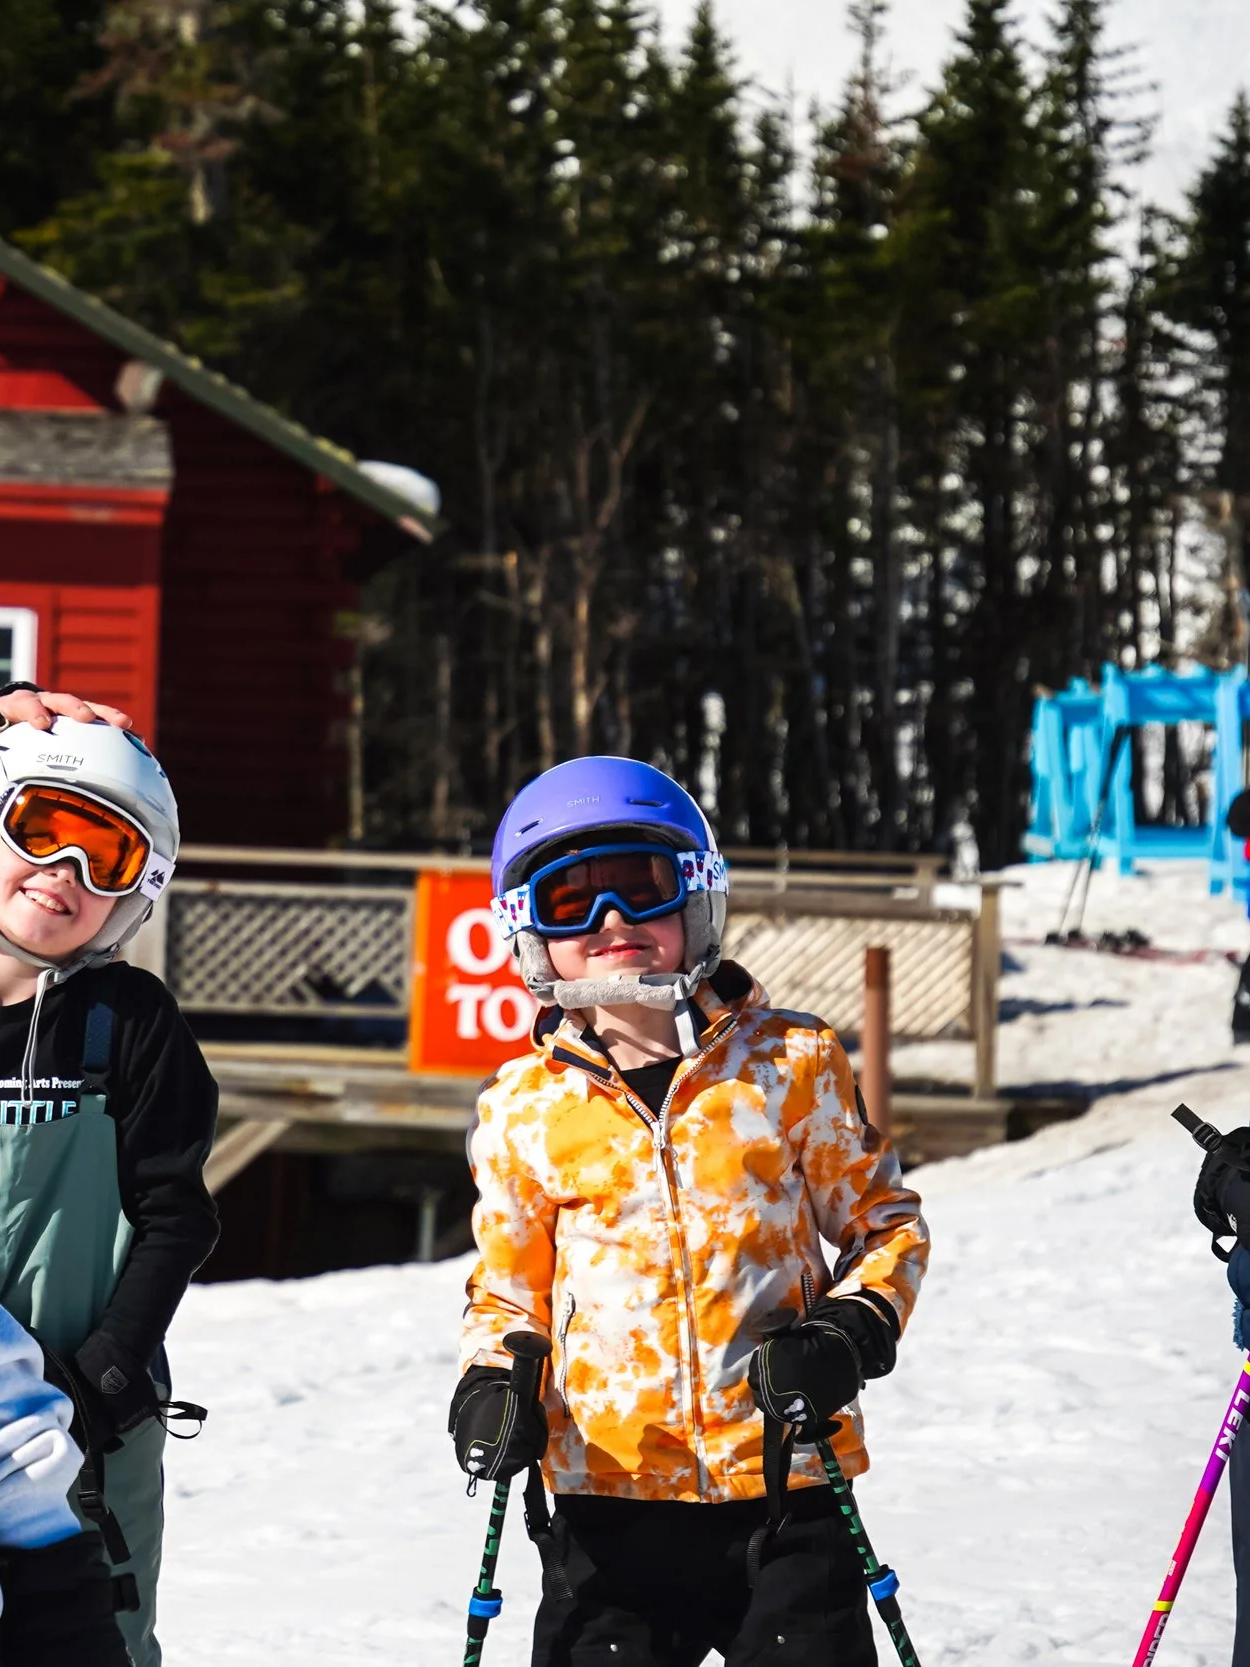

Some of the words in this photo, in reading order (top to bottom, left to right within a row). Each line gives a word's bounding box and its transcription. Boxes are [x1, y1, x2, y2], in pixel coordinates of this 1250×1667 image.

[36, 753, 84, 766] SMITH
[567, 796, 600, 808] SMITH
[1215, 1388, 1250, 1462] LEKI
